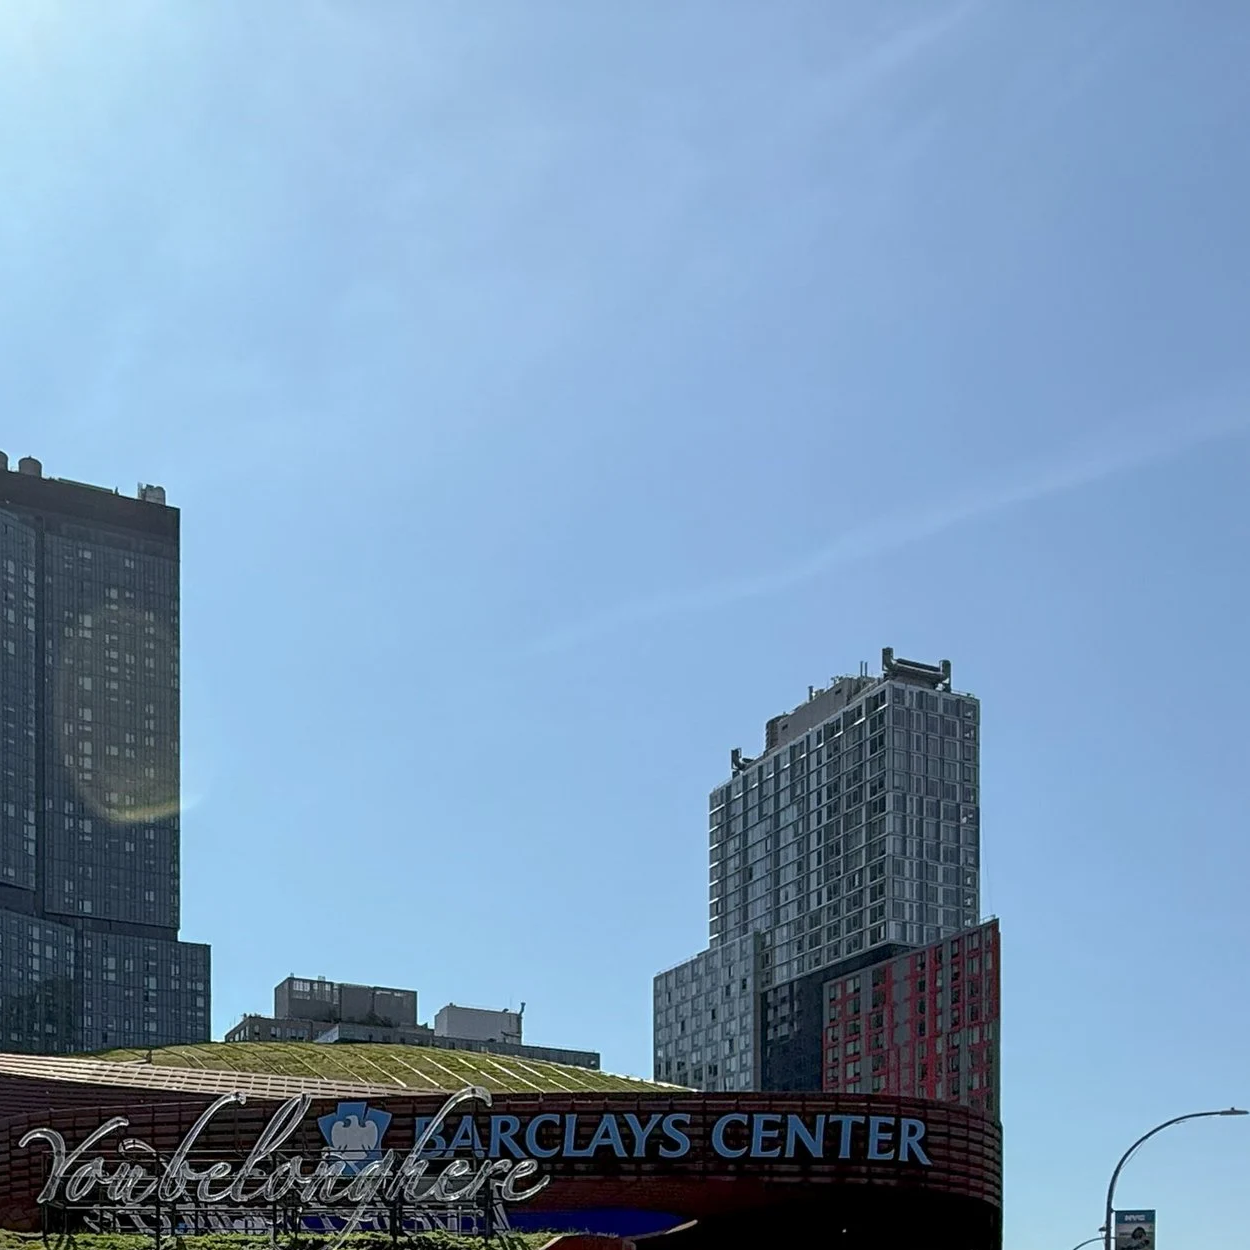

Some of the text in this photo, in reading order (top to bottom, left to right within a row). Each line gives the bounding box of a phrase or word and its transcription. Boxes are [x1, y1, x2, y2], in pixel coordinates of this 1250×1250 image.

[19, 1115, 156, 1203] You
[387, 1086, 550, 1203] here
[416, 1112, 933, 1166] BARCLAYS CENTER
